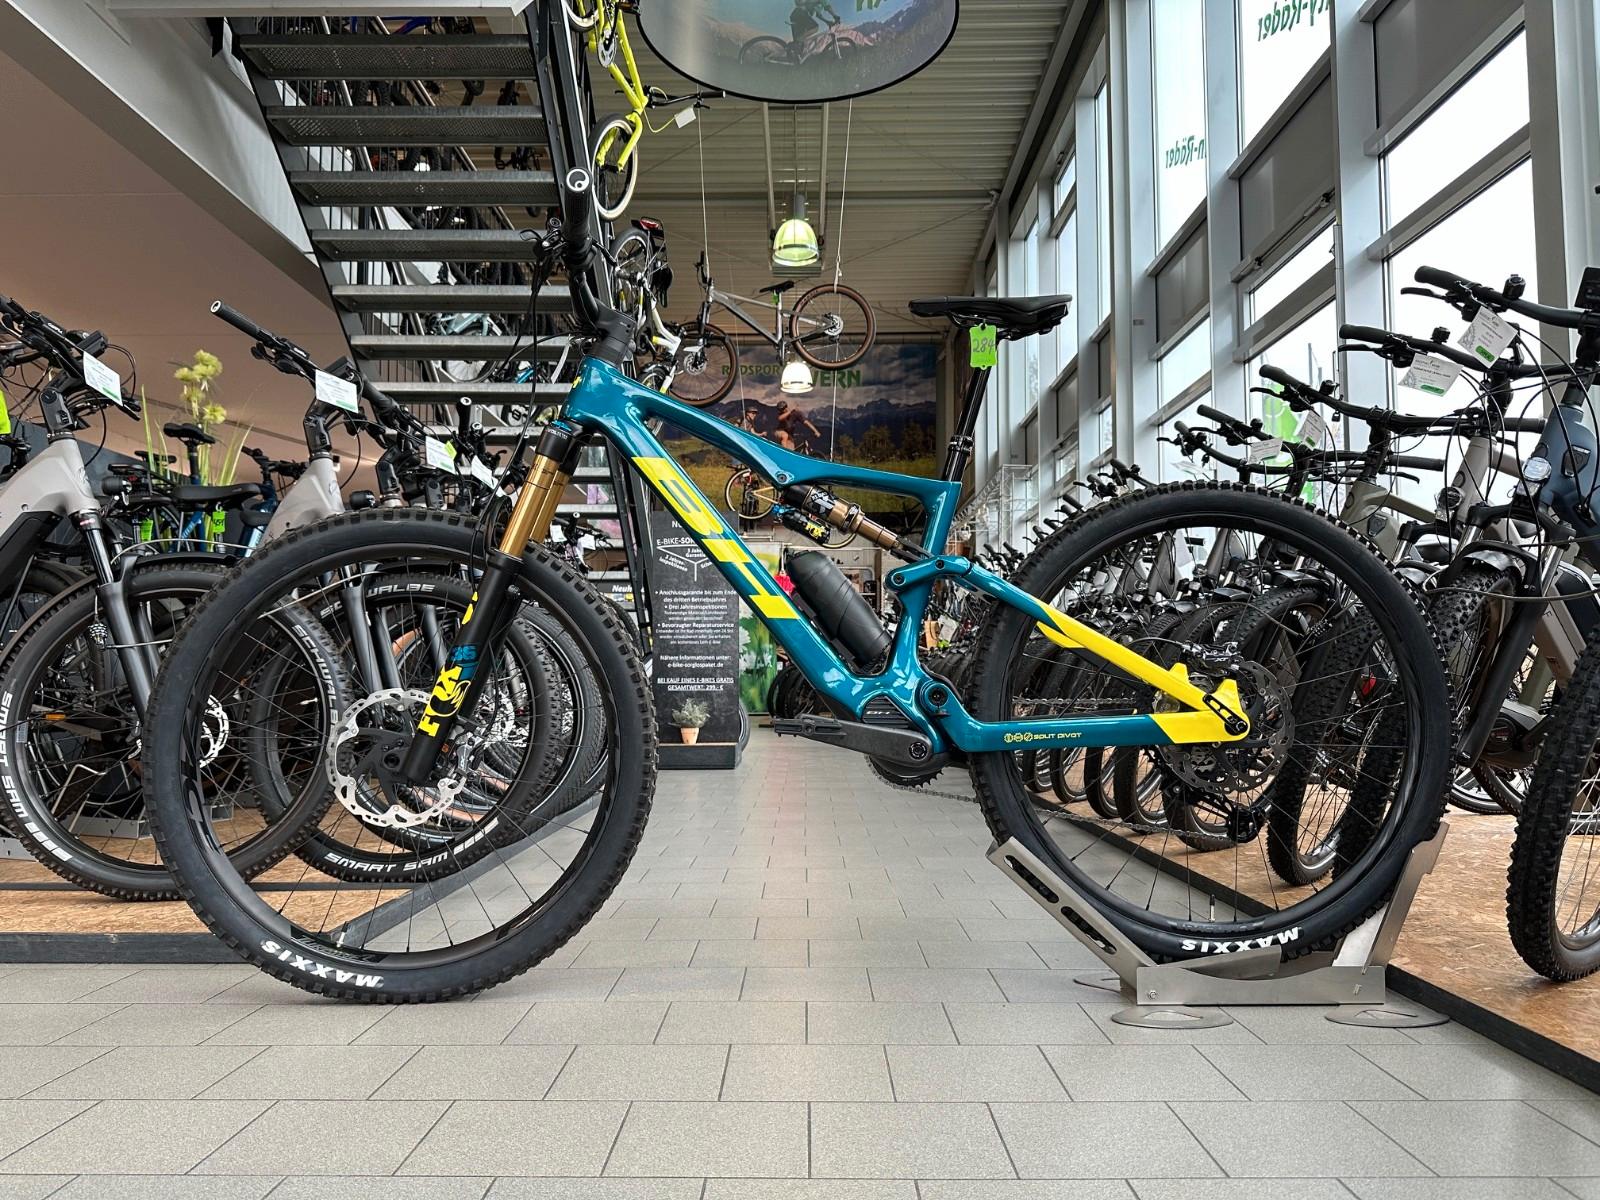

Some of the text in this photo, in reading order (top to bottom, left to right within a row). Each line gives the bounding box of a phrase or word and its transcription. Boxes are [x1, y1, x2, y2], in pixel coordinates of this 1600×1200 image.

[721, 364, 781, 376] RDSPOR
[656, 537, 695, 545] E-BIKE-SOR
[611, 584, 633, 593] Neuh
[291, 624, 339, 730] SCHWALB
[1, 775, 29, 819] SAM
[324, 851, 448, 873] SMART SAM
[1181, 926, 1300, 954] MAXXIS
[260, 939, 385, 989] MAXXIS
